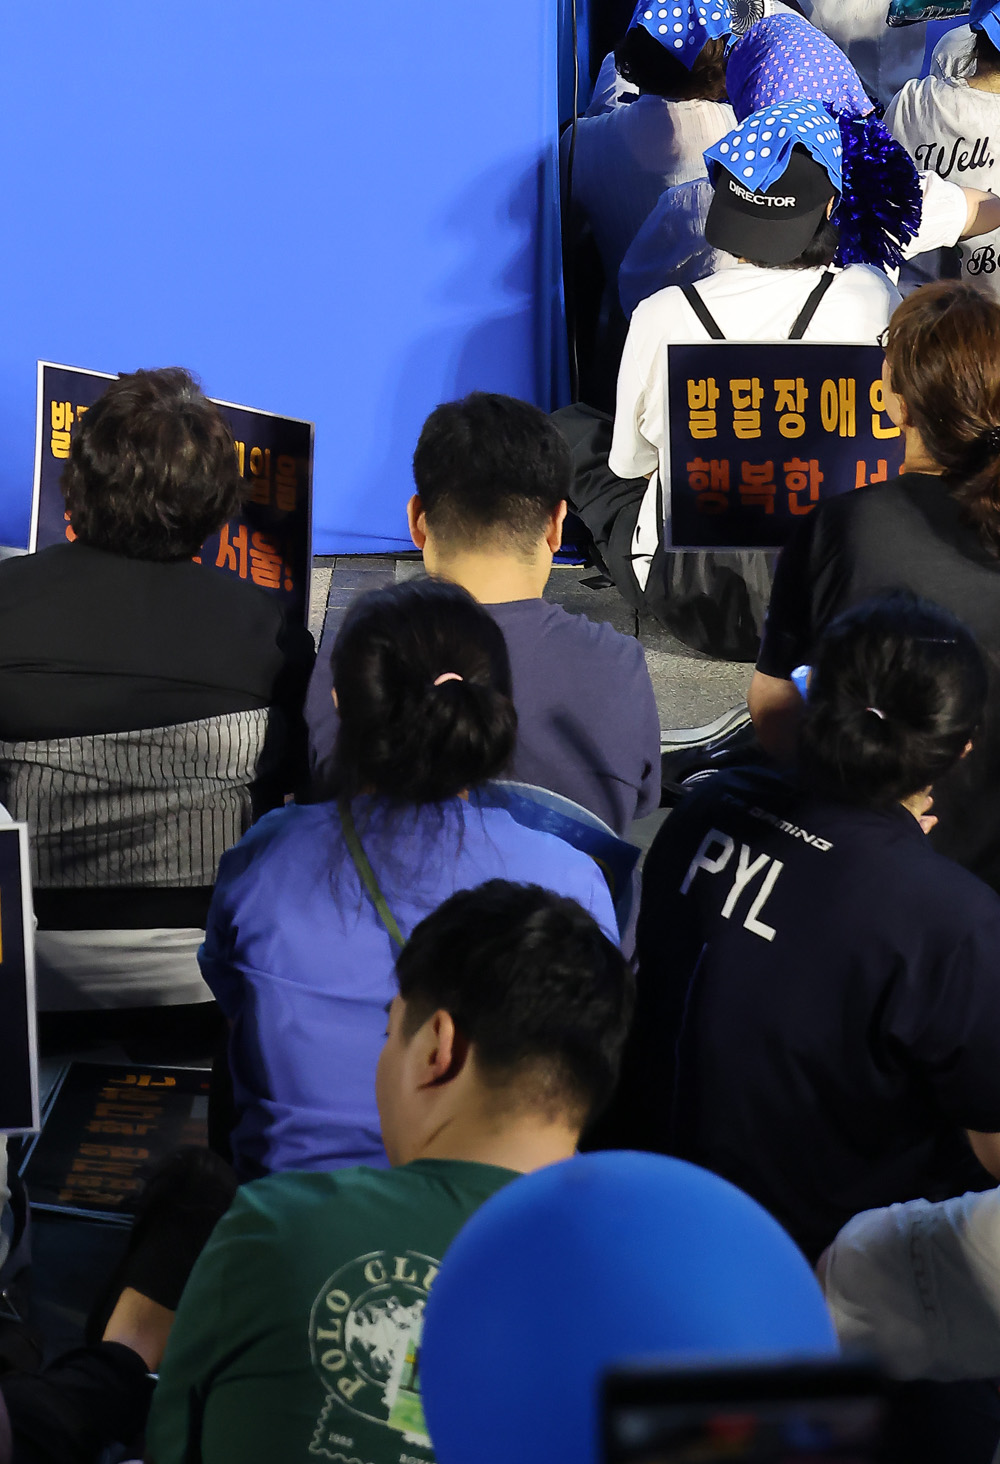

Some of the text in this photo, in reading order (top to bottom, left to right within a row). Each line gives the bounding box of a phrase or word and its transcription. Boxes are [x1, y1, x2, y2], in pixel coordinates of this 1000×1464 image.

[915, 136, 995, 179] Well,
[728, 179, 796, 208] DIRECTOR
[686, 456, 824, 515] 행복한
[679, 827, 785, 942] PYL
[316, 1288, 367, 1402] POLO
